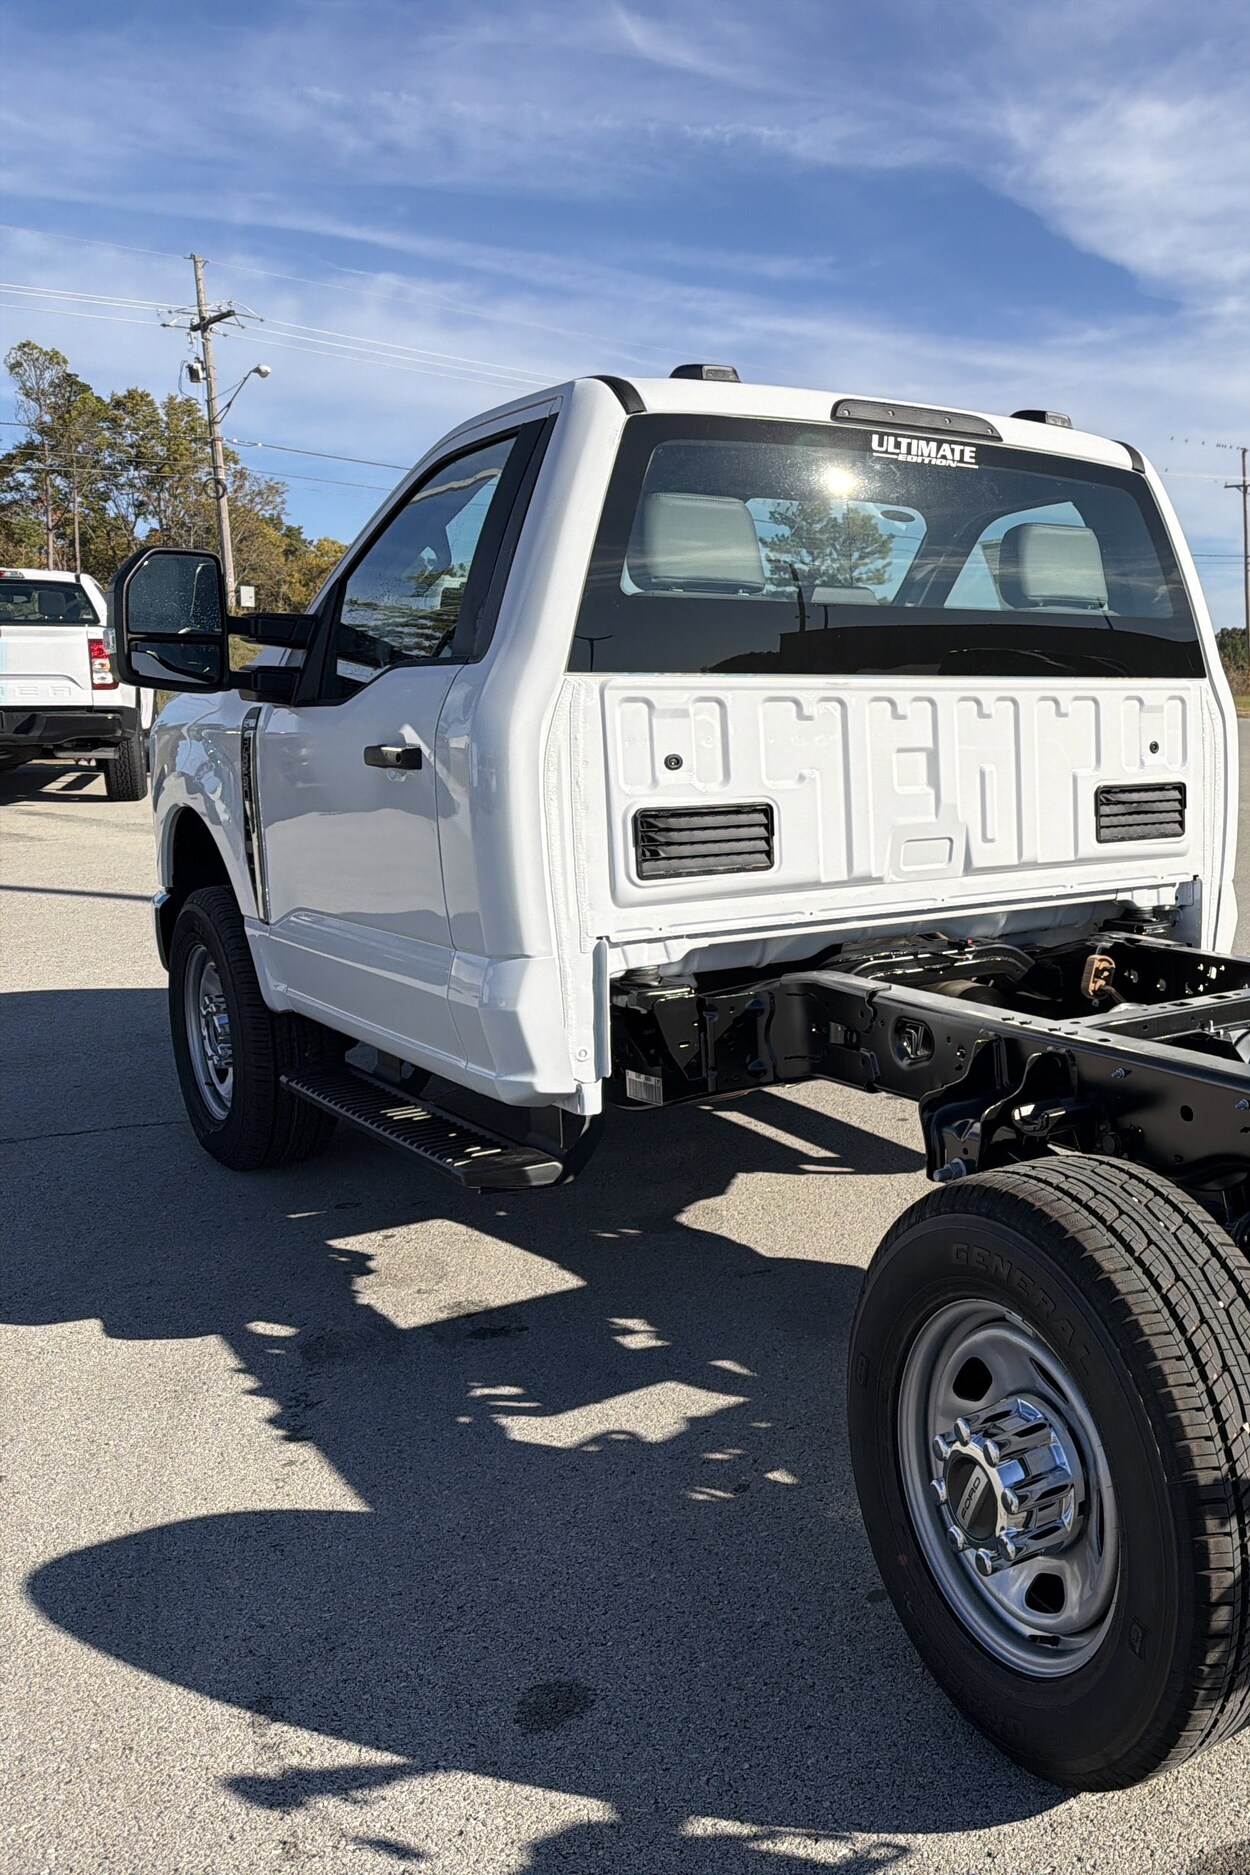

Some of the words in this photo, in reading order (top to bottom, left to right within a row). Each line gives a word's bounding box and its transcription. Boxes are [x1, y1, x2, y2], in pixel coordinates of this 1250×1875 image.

[871, 433, 977, 464] ULTIMATE
[897, 453, 958, 468] EDITION
[951, 1241, 1091, 1376] GENERAL
[960, 1476, 981, 1521] FORD
